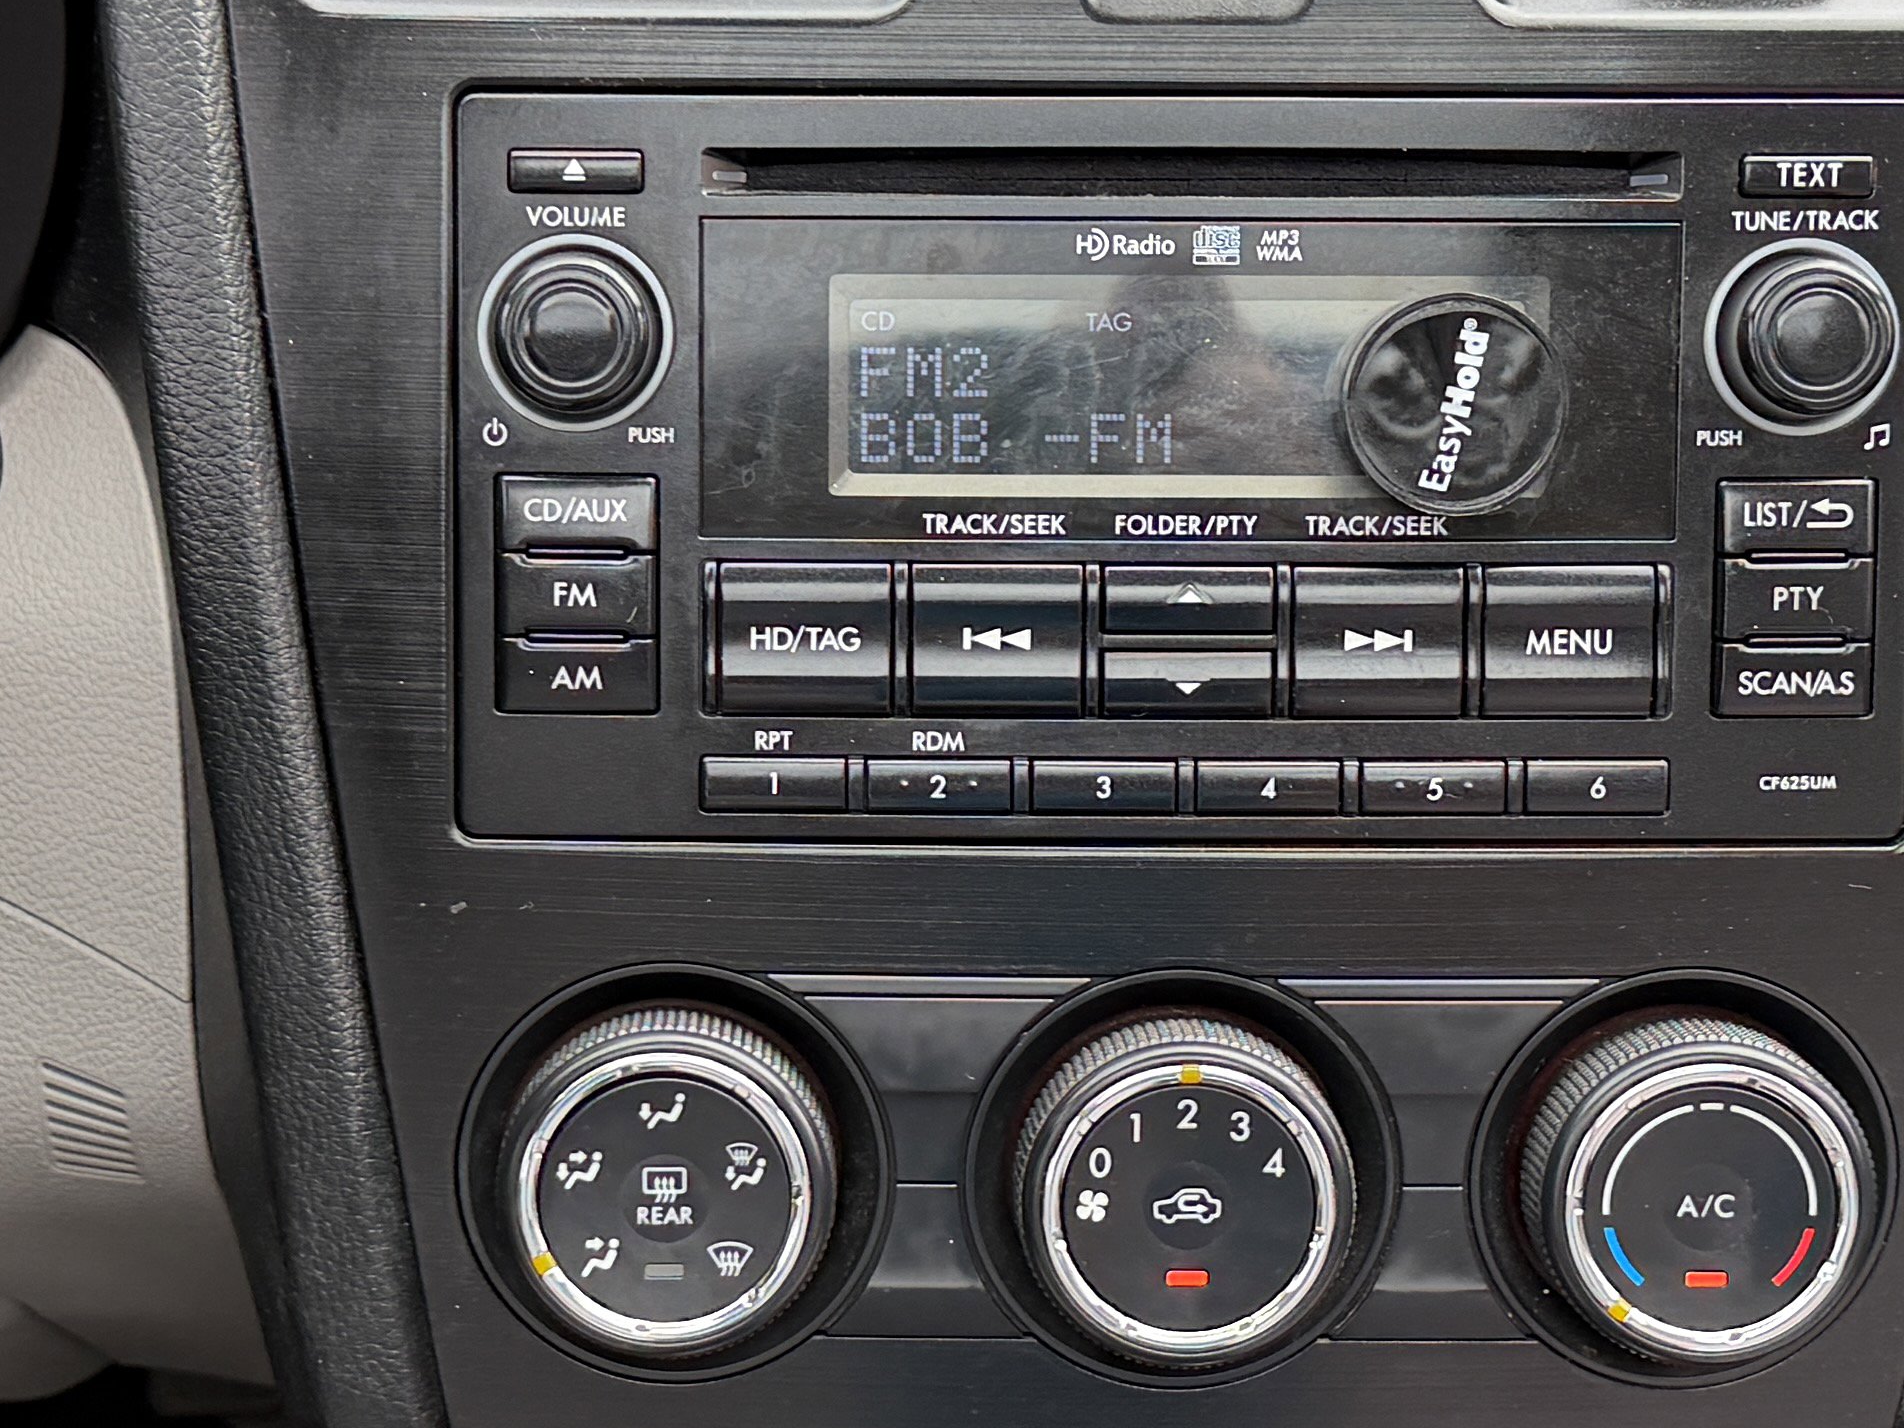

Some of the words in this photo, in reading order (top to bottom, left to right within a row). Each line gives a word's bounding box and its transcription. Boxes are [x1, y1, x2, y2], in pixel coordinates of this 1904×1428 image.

[1777, 163, 1843, 188] TEXT
[525, 206, 626, 227] VOLUME
[1731, 210, 1879, 232] TUNE/TRACK
[1113, 233, 1176, 256] Radio
[1260, 229, 1300, 246] MP3
[1256, 246, 1303, 262] WMA
[861, 311, 896, 332] CD
[1085, 312, 1132, 333] TAG
[859, 346, 988, 398] FM2
[628, 427, 674, 444] PUSH
[860, 413, 988, 463] BOB
[1696, 430, 1742, 447] PUSH
[523, 497, 628, 524] CD/AUX
[923, 513, 1066, 537] TRACK/SEEK
[1115, 514, 1258, 538] FOLDER/PTY
[1306, 515, 1448, 538] TRACK/SEEK
[553, 583, 596, 607] FM
[1773, 586, 1823, 611] PTY
[750, 626, 862, 654] HD/TAG
[1526, 629, 1613, 655] MENU
[551, 667, 604, 690] AM
[754, 731, 793, 751] RPT
[912, 732, 965, 752] RDM
[770, 773, 779, 795] 1
[930, 775, 947, 800] 2
[1096, 776, 1112, 799] 3
[1260, 778, 1276, 800] 4
[1426, 778, 1442, 802] 5
[1590, 777, 1606, 800] 6
[1759, 775, 1837, 791] CF625UM
[1176, 1099, 1198, 1129] 2
[1129, 1113, 1142, 1143] 1
[1229, 1111, 1250, 1142] 3
[1088, 1147, 1112, 1179] 0
[1262, 1147, 1286, 1178] 4
[636, 1206, 694, 1225] REAR
[1676, 1194, 1735, 1218] A/C
